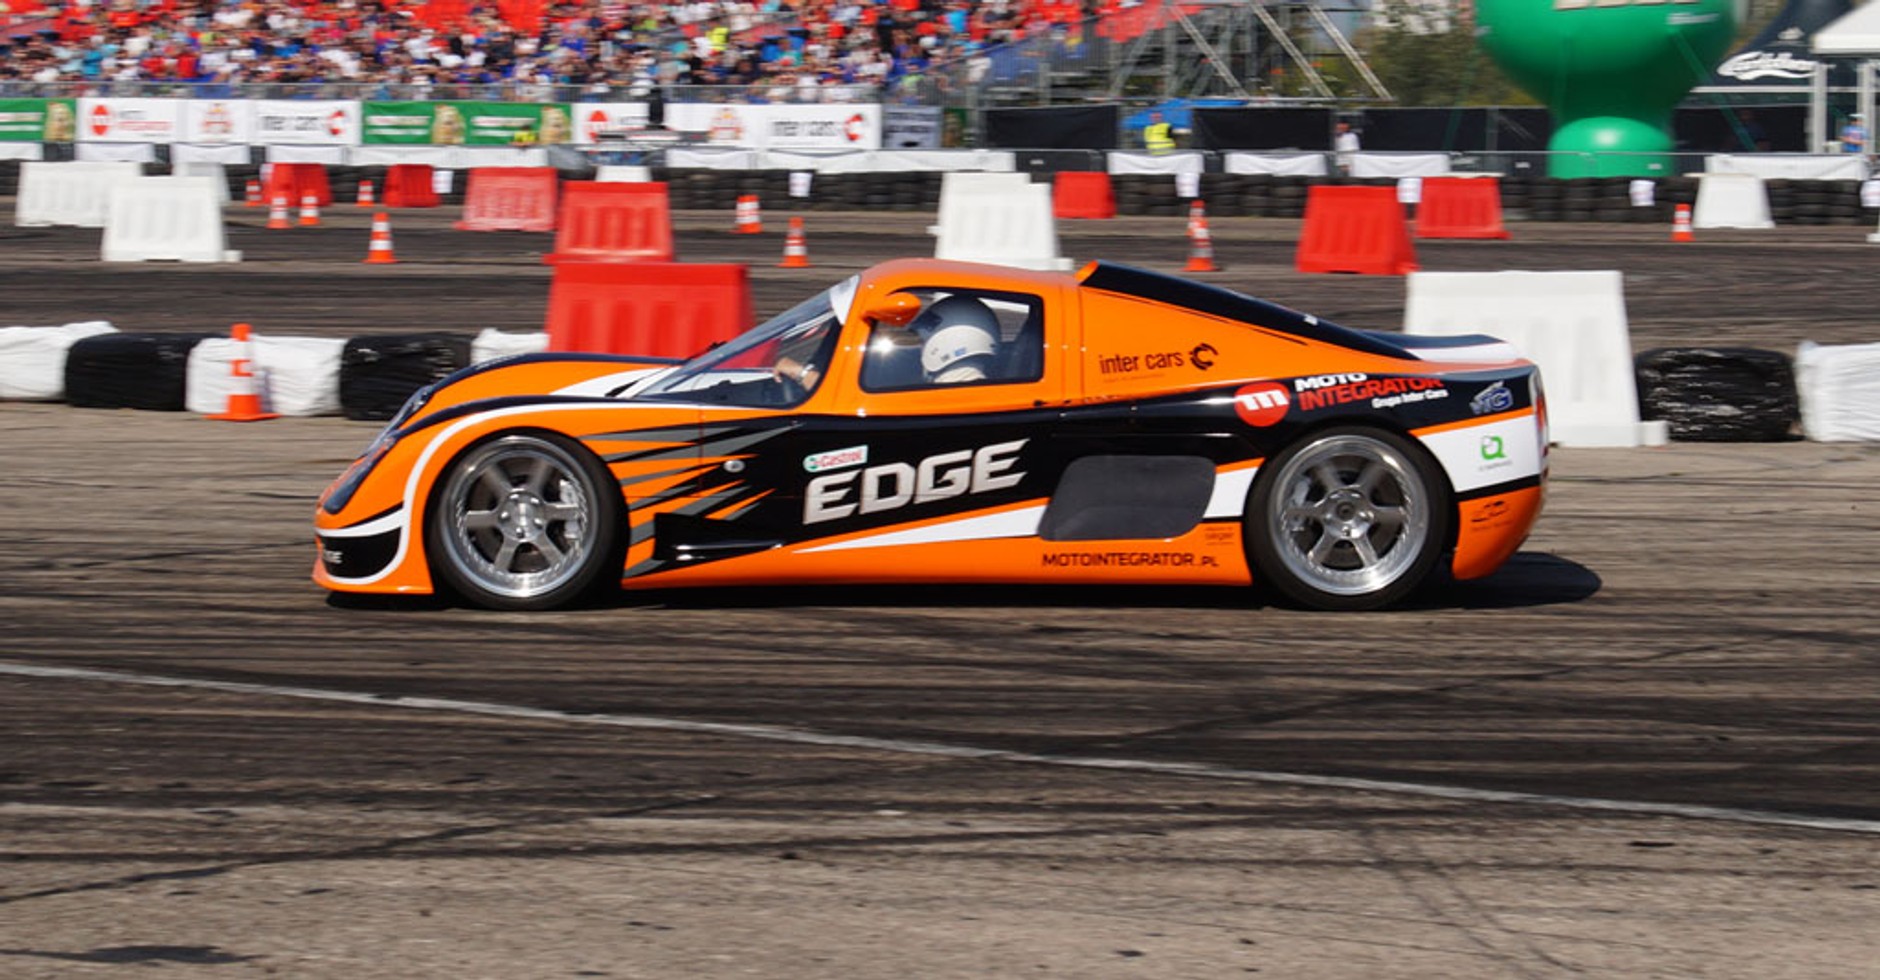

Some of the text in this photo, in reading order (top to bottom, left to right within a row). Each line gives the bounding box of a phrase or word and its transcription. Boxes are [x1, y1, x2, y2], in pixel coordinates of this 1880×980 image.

[1099, 352, 1184, 374] inter cars
[1294, 373, 1367, 392] MOTO
[1297, 378, 1444, 411] INTEGRATOR
[1424, 389, 1448, 400] Cars
[820, 450, 863, 468] Castrol
[803, 438, 1032, 525] EDGE
